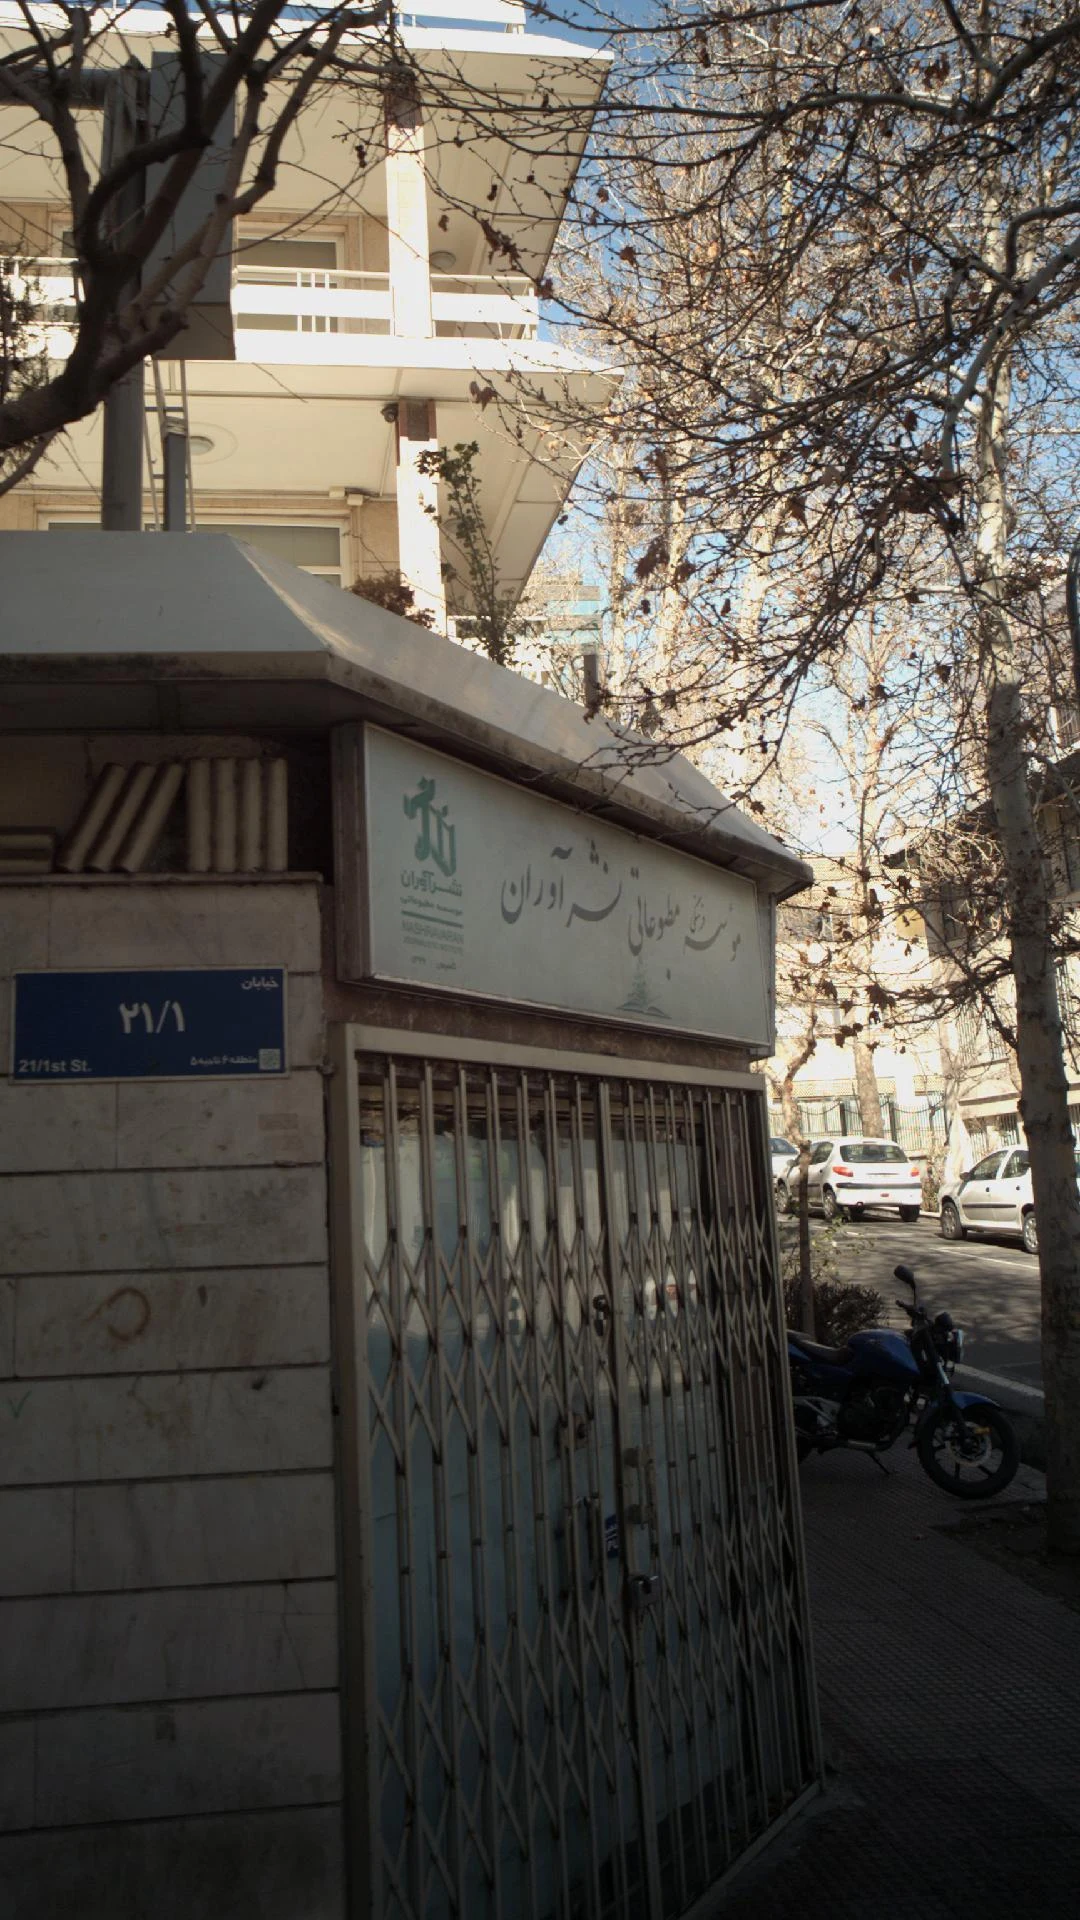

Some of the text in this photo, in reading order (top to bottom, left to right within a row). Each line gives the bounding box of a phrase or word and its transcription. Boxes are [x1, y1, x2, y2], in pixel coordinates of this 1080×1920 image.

[628, 867, 680, 980] مطبوعاتی
[241, 977, 279, 990] خیابان
[119, 1000, 186, 1034] ۲۱/۱
[19, 1059, 91, 1073] 21/1st St.
[230, 1056, 258, 1065] منطقه
